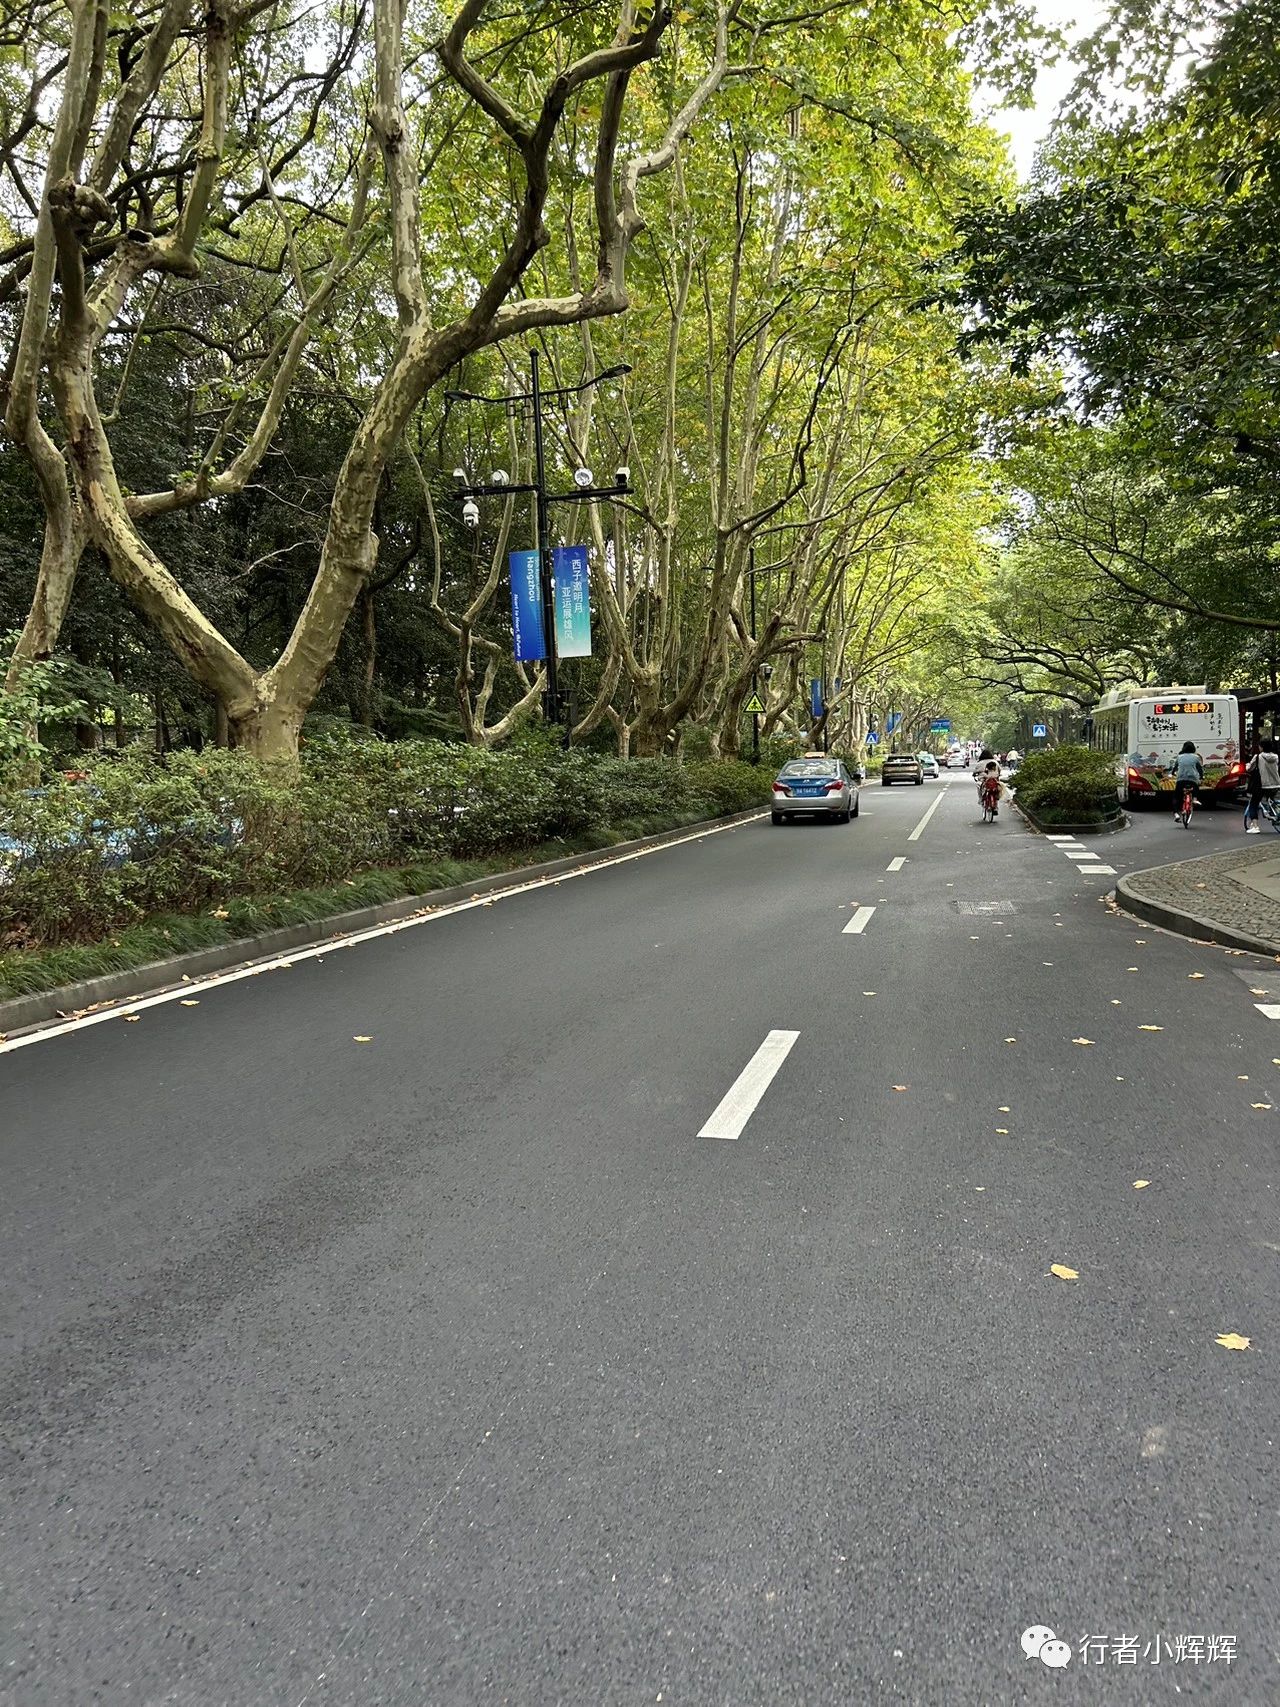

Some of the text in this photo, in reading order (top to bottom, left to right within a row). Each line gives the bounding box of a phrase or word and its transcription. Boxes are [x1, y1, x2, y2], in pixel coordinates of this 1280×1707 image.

[526, 556, 535, 602] Hangzhou
[572, 559, 583, 614] 西子邀明月
[562, 586, 574, 640] 亚运展雄风
